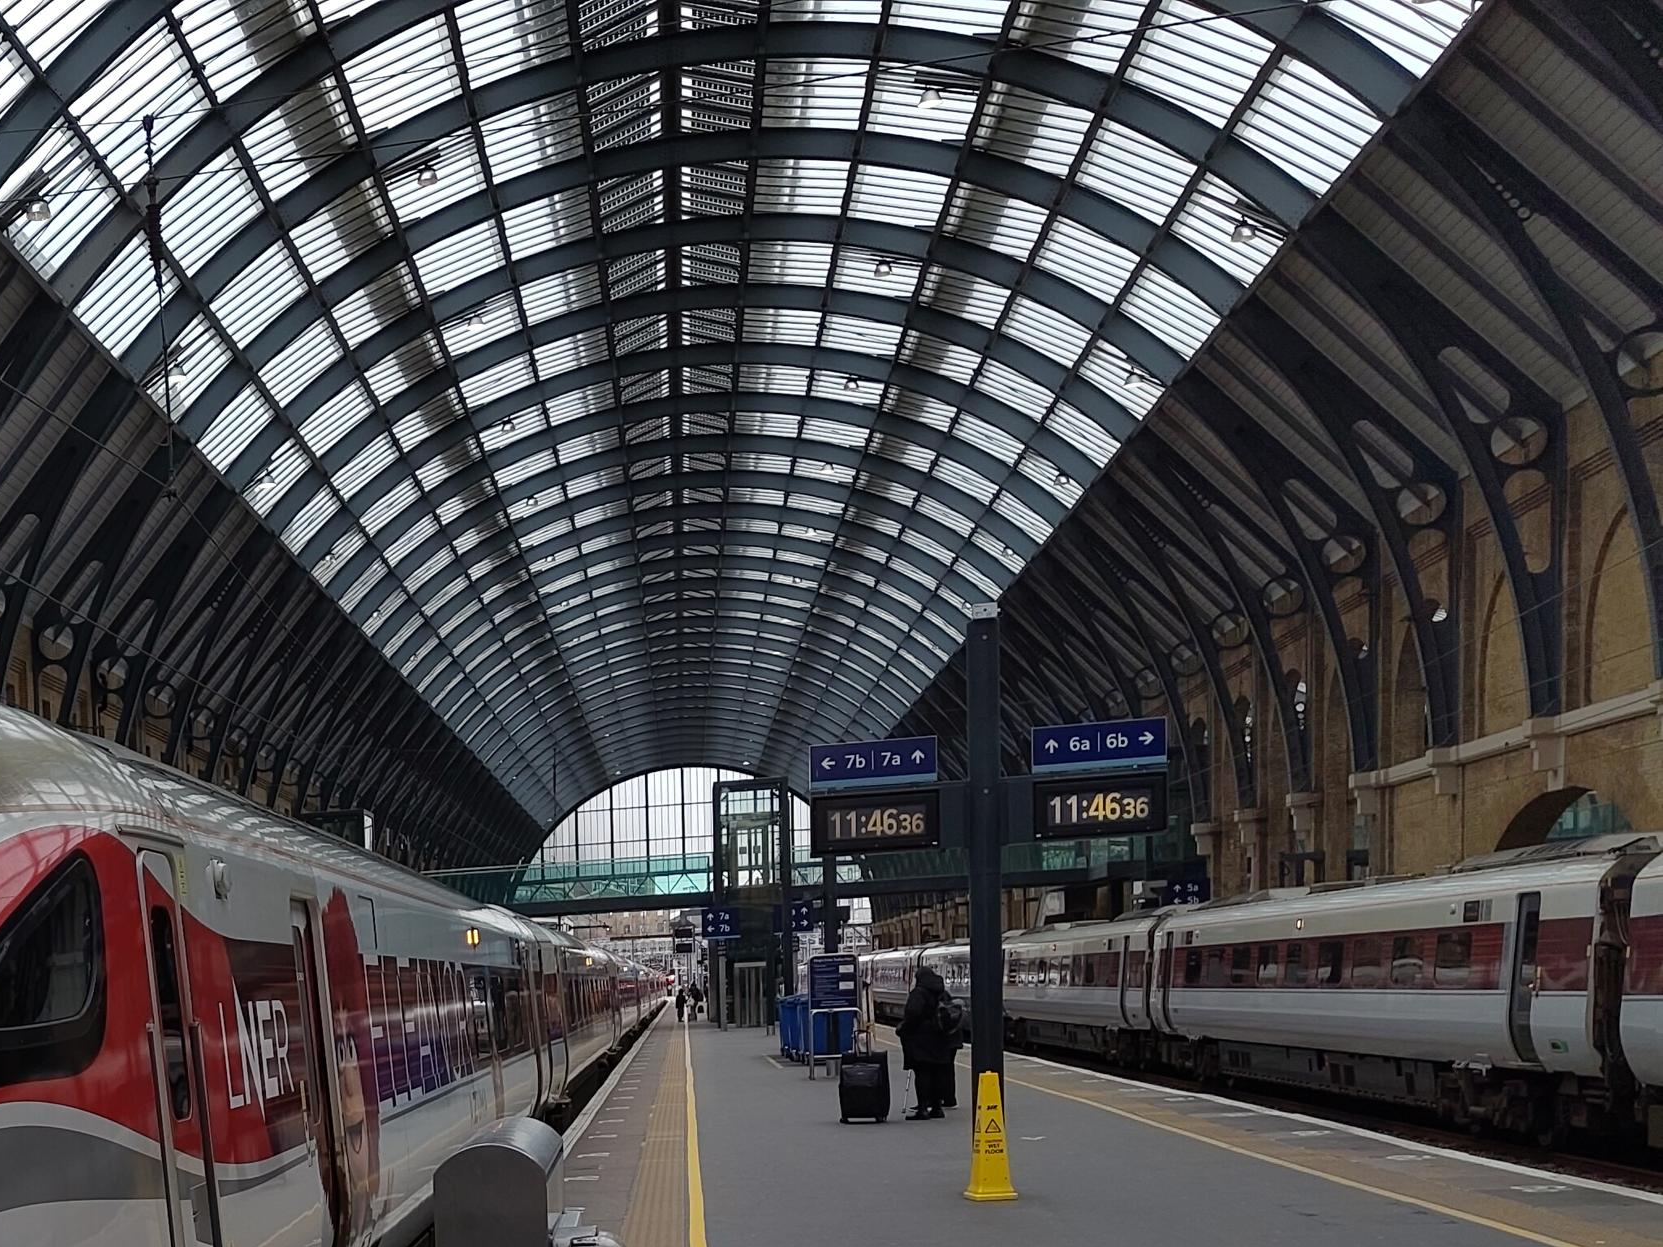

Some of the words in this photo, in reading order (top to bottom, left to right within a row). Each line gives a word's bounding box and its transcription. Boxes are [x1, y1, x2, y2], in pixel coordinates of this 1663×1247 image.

[1069, 737, 1090, 751] 6a
[1106, 732, 1128, 748] 6b
[844, 754, 866, 769] 7b
[881, 752, 901, 766] 7a
[1187, 883, 1199, 892] 5a
[719, 912, 729, 920] 7a
[719, 924, 730, 932] 7b
[363, 953, 475, 1114] ELEANOR
[219, 976, 294, 1123] LNER
